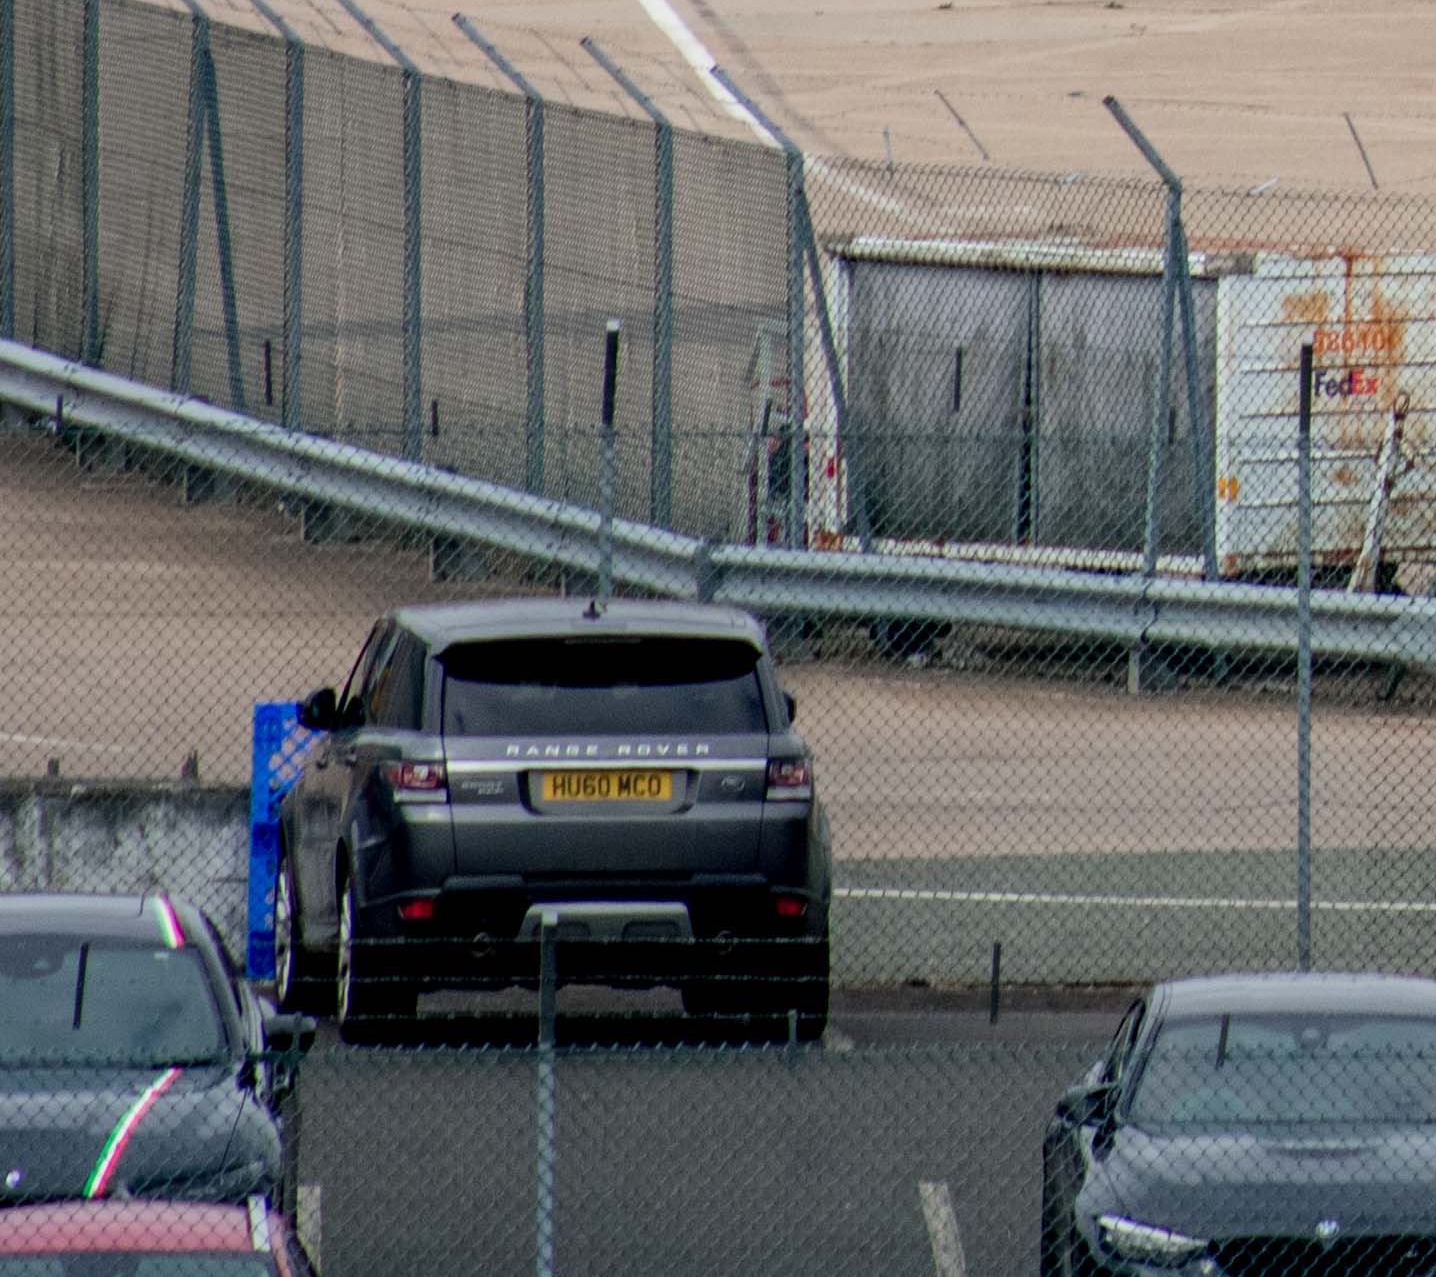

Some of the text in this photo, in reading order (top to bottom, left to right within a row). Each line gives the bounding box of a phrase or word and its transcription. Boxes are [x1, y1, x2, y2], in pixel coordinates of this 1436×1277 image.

[1314, 367, 1378, 398] FedEx
[506, 743, 710, 758] RANGE ROVER
[551, 774, 662, 797] HU60 MCO
